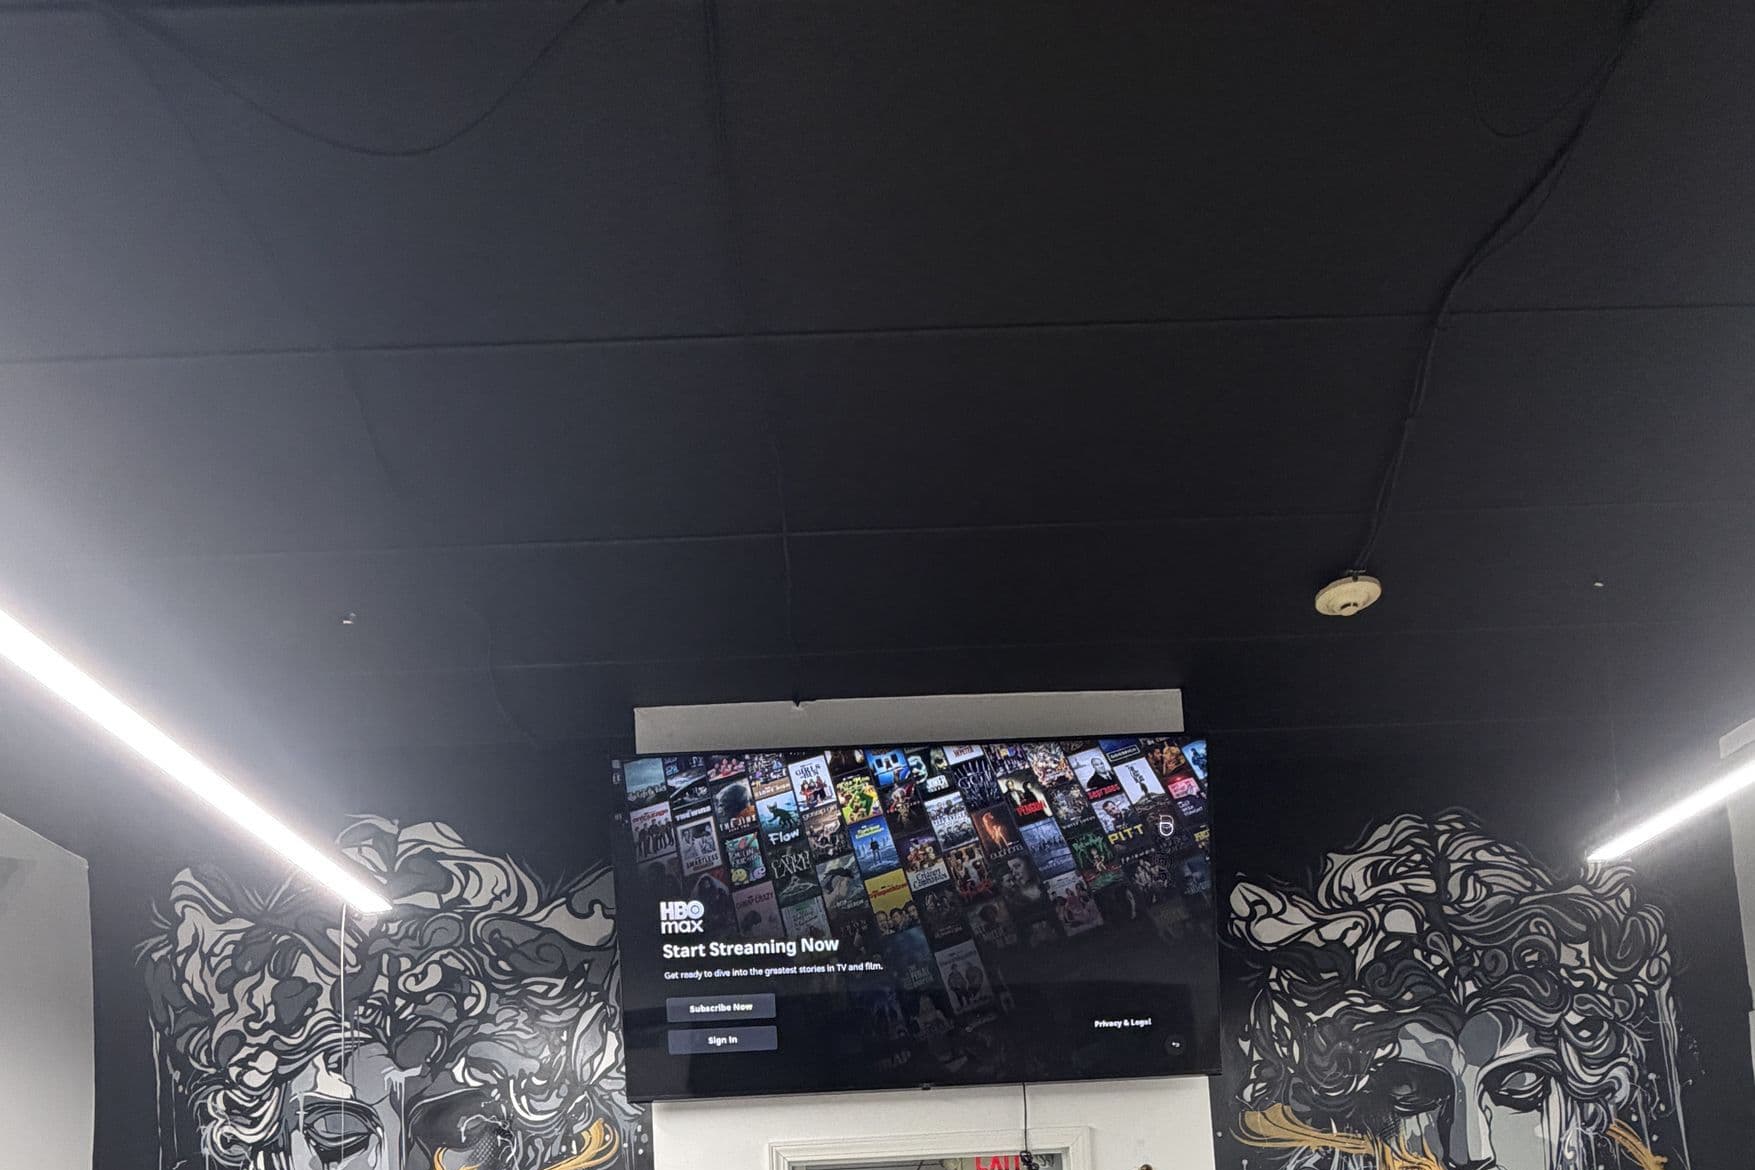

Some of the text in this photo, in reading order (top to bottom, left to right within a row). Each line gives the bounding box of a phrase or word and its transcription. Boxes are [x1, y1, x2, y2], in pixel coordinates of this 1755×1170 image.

[767, 828, 800, 846] Flow
[1107, 823, 1144, 845] PITT
[660, 900, 705, 920] HBO
[661, 920, 704, 934] max
[663, 938, 840, 959] Start Streaming Now
[664, 961, 884, 980] Get ready to dive into the greatest stories in TV and film.
[689, 1003, 753, 1013] Subscribe Now
[1094, 1018, 1152, 1029] Privacy & Legal
[708, 1035, 738, 1047] Sign In
